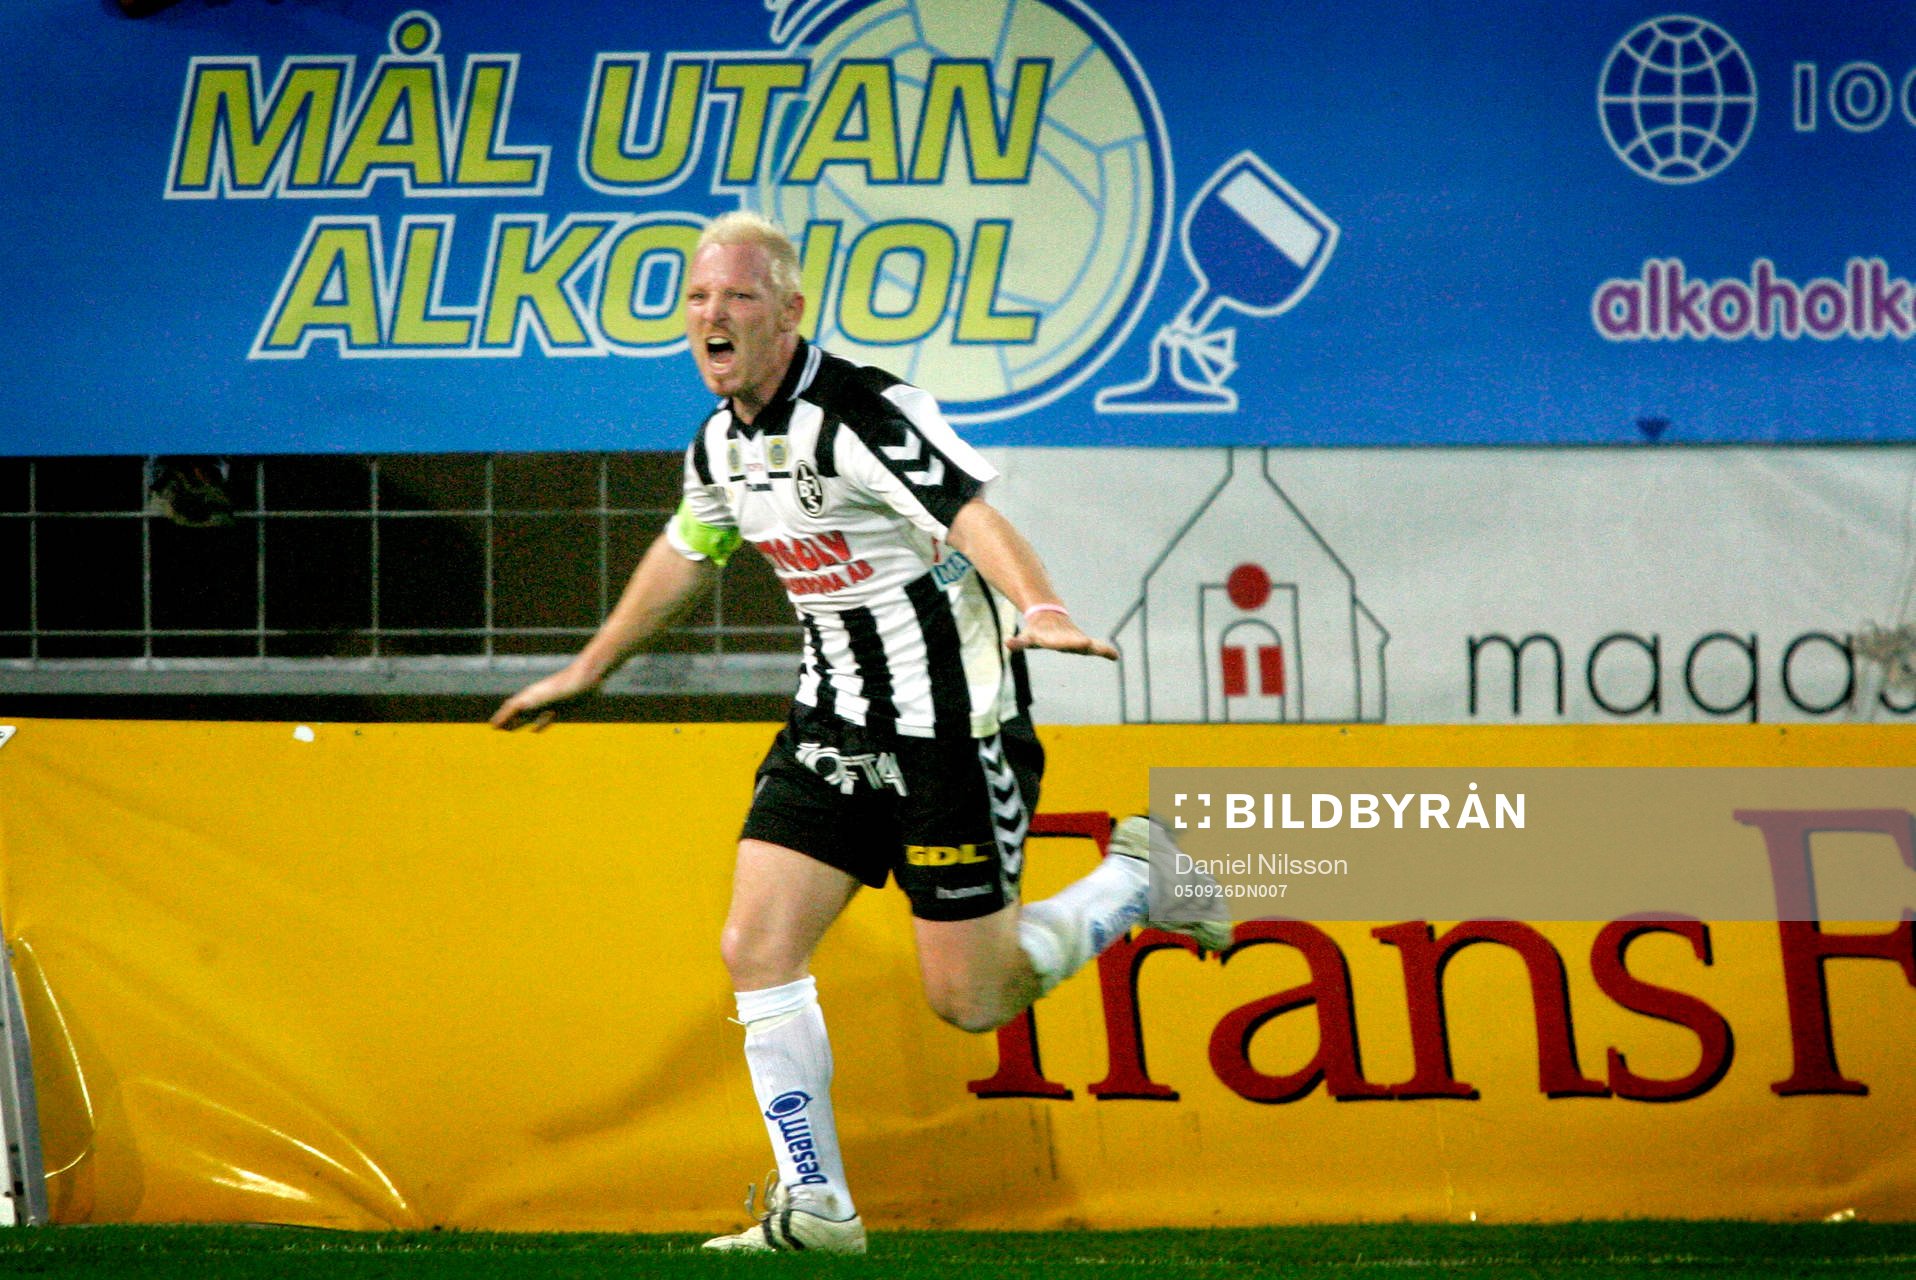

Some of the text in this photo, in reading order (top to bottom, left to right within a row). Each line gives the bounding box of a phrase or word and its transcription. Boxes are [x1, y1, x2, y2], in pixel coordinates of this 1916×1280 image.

[163, 10, 1053, 199] MÅL UTAN
[1793, 62, 1916, 132] IO
[1592, 257, 1916, 341] alkoholk
[778, 1117, 828, 1185] besam
